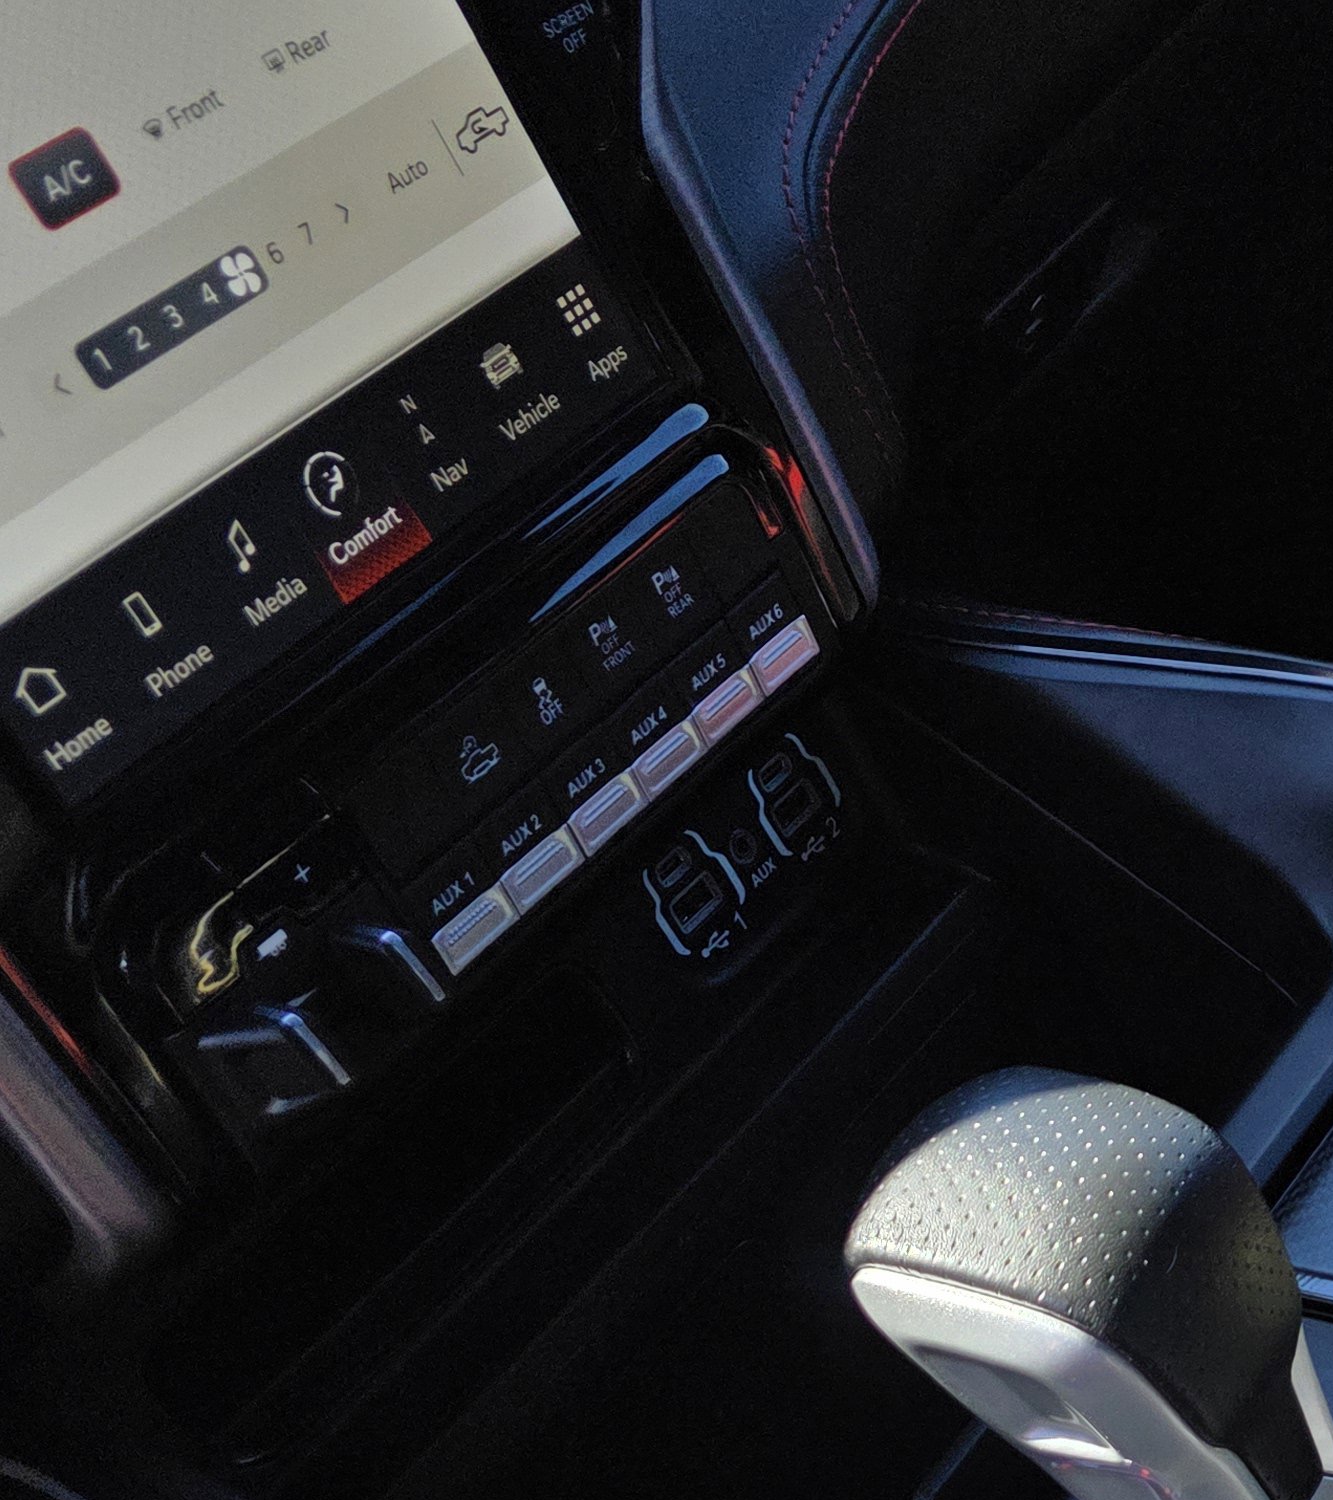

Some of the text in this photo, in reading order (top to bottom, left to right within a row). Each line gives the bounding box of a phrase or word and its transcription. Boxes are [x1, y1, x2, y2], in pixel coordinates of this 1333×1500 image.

[542, 0, 594, 38] SCREEN
[285, 27, 332, 65] Rear
[563, 28, 587, 53] OFF
[166, 89, 225, 130] Front
[43, 159, 92, 202] A/C
[387, 157, 429, 194] Auto
[92, 222, 315, 372] 1 2 3 4 6 7
[587, 346, 628, 382] Apps
[400, 394, 417, 414] N
[498, 392, 561, 441] Vehicle
[430, 458, 469, 492] Nav
[328, 505, 403, 566] Comfort
[242, 575, 308, 627] Media
[664, 582, 683, 603] OFF
[667, 593, 695, 619] REAR
[749, 603, 784, 641] AUX 6
[601, 634, 620, 655] OFF
[602, 641, 636, 672] FRONT
[144, 643, 214, 698] Phone
[691, 653, 727, 691] AUX 5
[539, 699, 565, 725] OFF
[630, 705, 668, 746] AUX 4
[43, 718, 113, 771] Home
[567, 758, 606, 799] AUX 3
[501, 814, 543, 857] AUX 2
[826, 818, 841, 838] 2
[751, 857, 777, 888] AUX
[431, 872, 475, 917] AUX 1
[733, 911, 748, 930] 1
